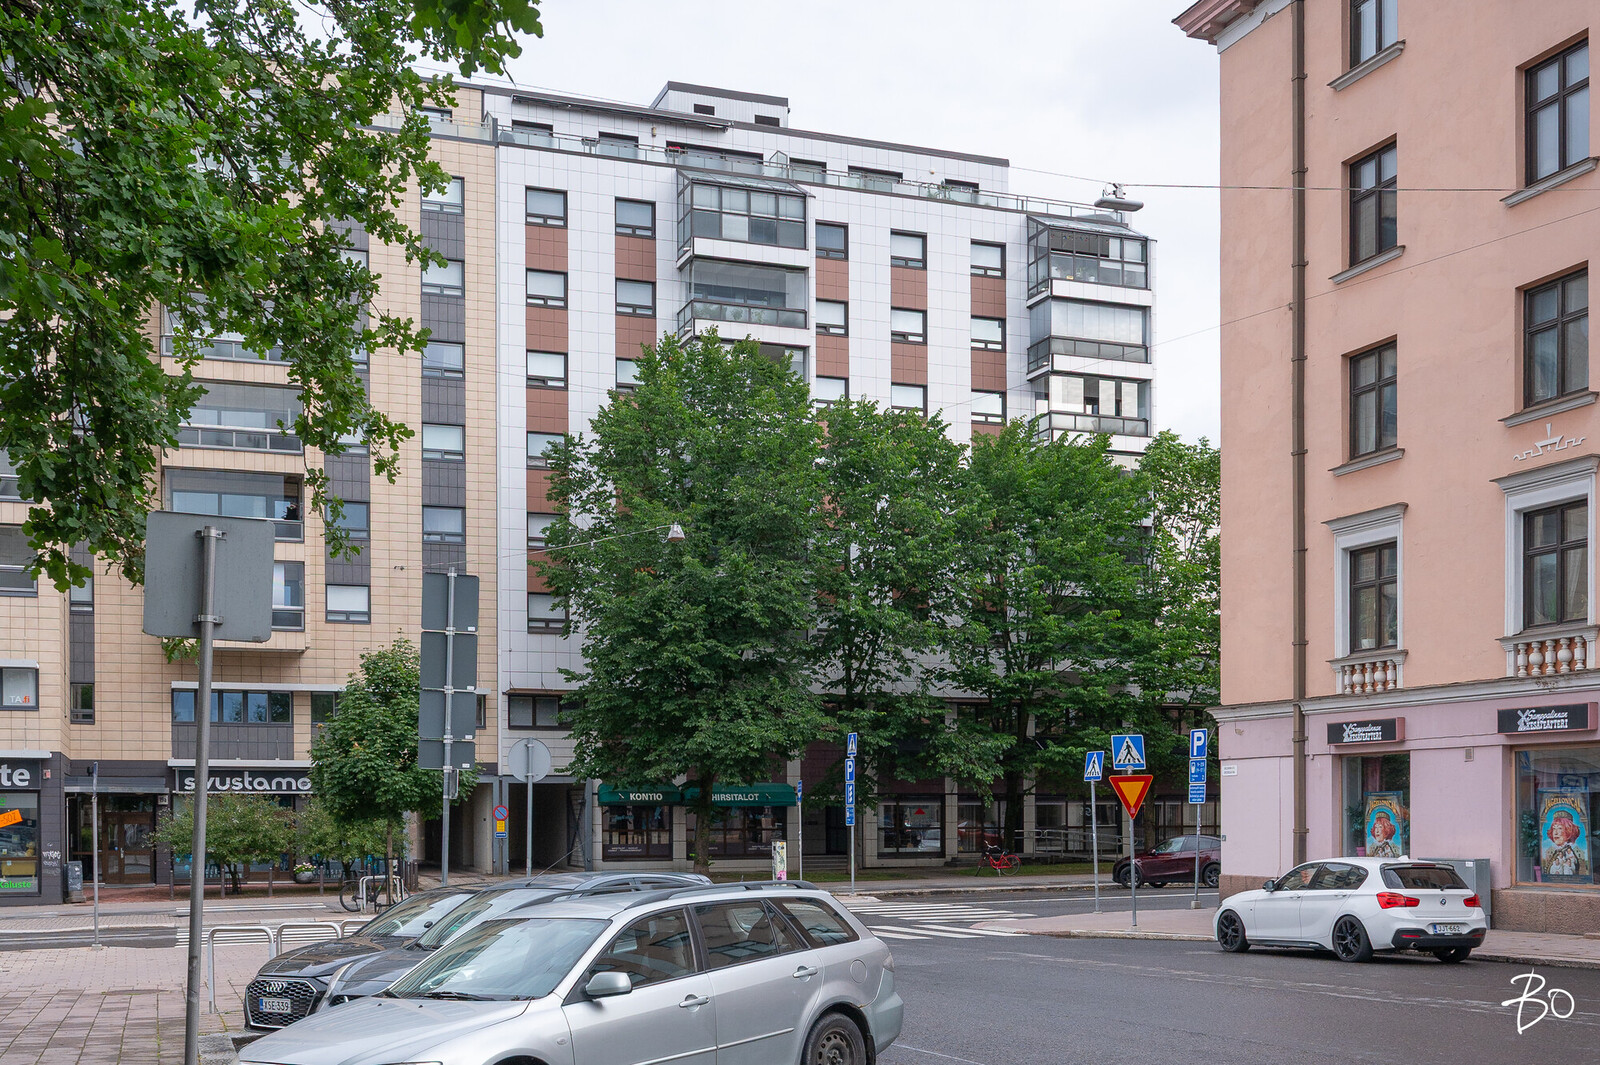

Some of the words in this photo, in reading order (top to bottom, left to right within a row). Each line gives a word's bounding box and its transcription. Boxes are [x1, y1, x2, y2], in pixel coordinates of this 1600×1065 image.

[9, 695, 31, 704] TA.fi
[1193, 731, 1205, 756] P
[847, 760, 854, 780] P
[183, 771, 312, 791] svustamo
[629, 792, 663, 801] KONTIO
[711, 793, 760, 802] HIRSITALOT
